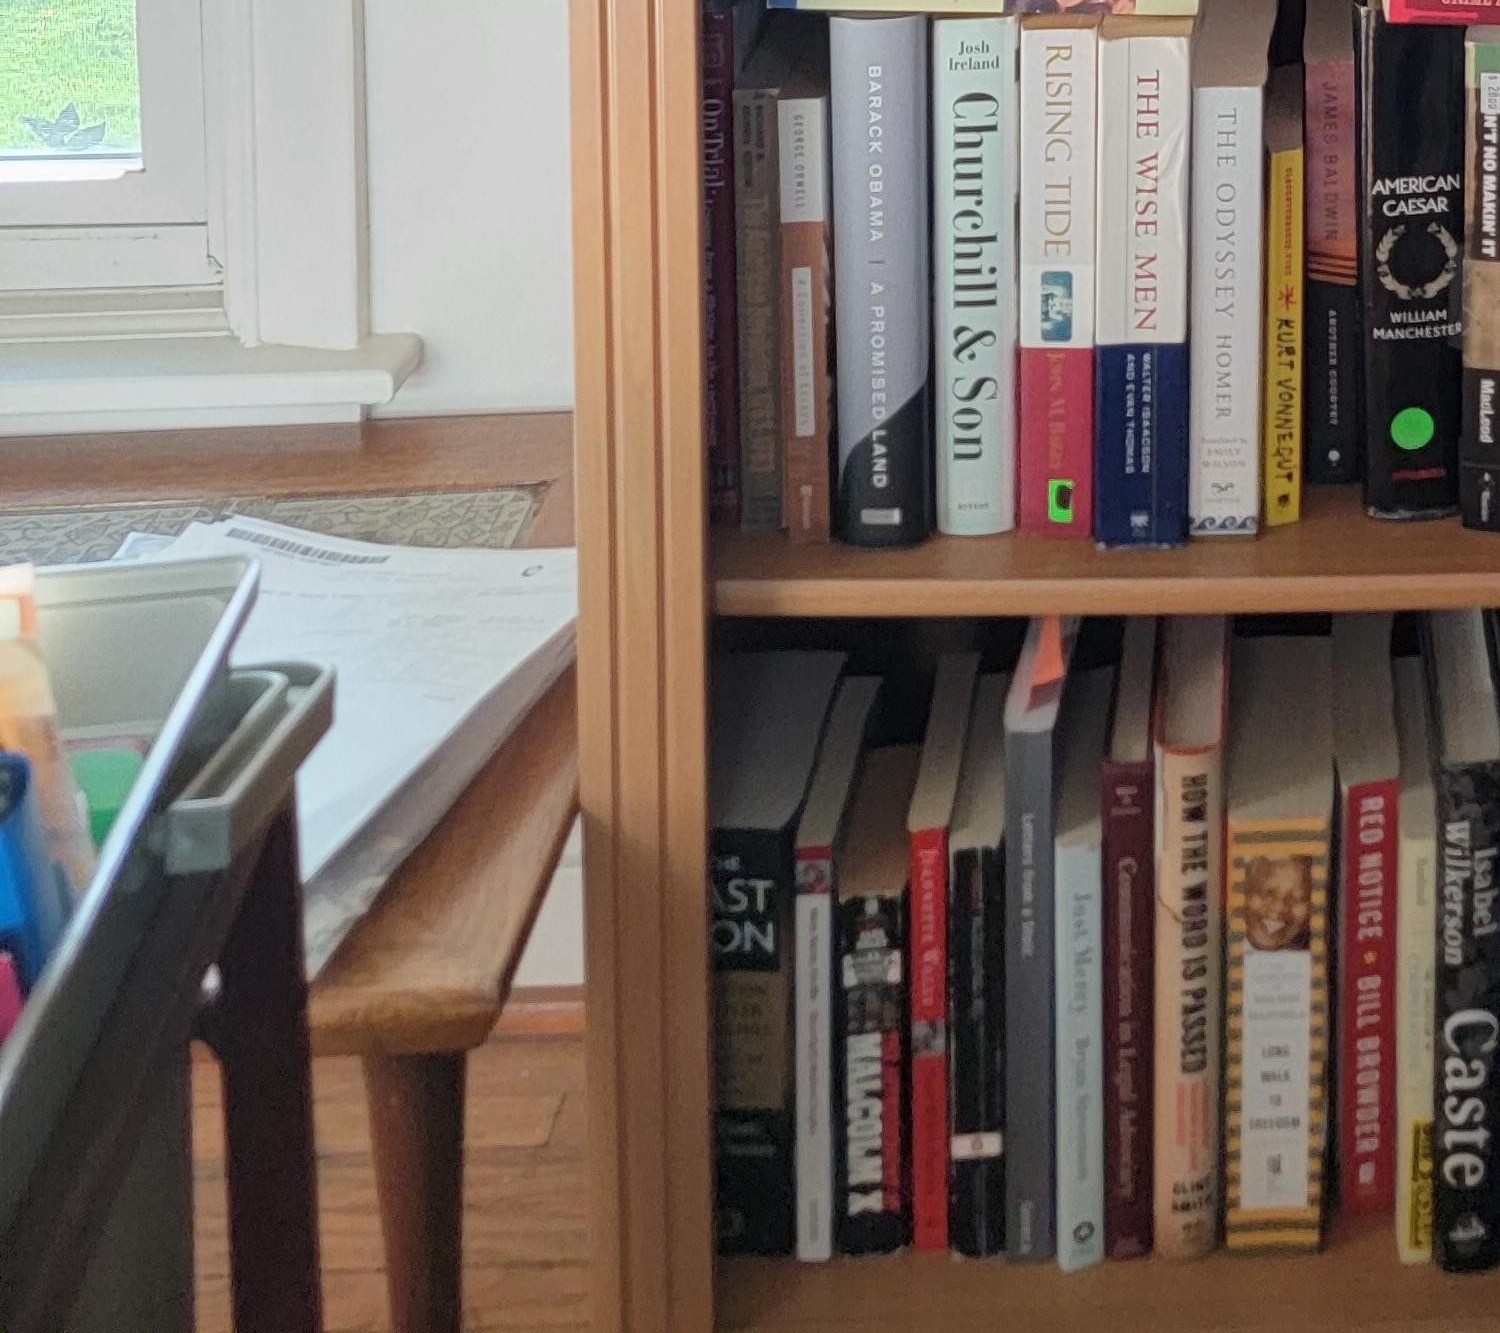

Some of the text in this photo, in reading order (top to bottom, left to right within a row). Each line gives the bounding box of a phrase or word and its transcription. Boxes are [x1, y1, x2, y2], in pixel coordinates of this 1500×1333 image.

[867, 64, 885, 243] BARACK OBAMA
[1044, 43, 1073, 258] RISING TIDE
[1134, 69, 1160, 332] THE WISE MEN
[1371, 173, 1461, 196] AMERICAN
[1382, 195, 1450, 218] CAESAR
[951, 91, 999, 462] Churchill & Son
[1215, 107, 1237, 420] THE ODYSSEY HOMER
[1181, 774, 1208, 822] HOW
[1181, 830, 1208, 872] THE
[1356, 795, 1385, 942] RED NOTICE
[1180, 884, 1208, 946] WORD
[1442, 819, 1473, 967] Wilkerson
[1179, 988, 1208, 1075] PASSED
[1180, 956, 1208, 982] IS
[847, 1032, 883, 1215] MALCOLM X
[1442, 1008, 1500, 1189] Caste
